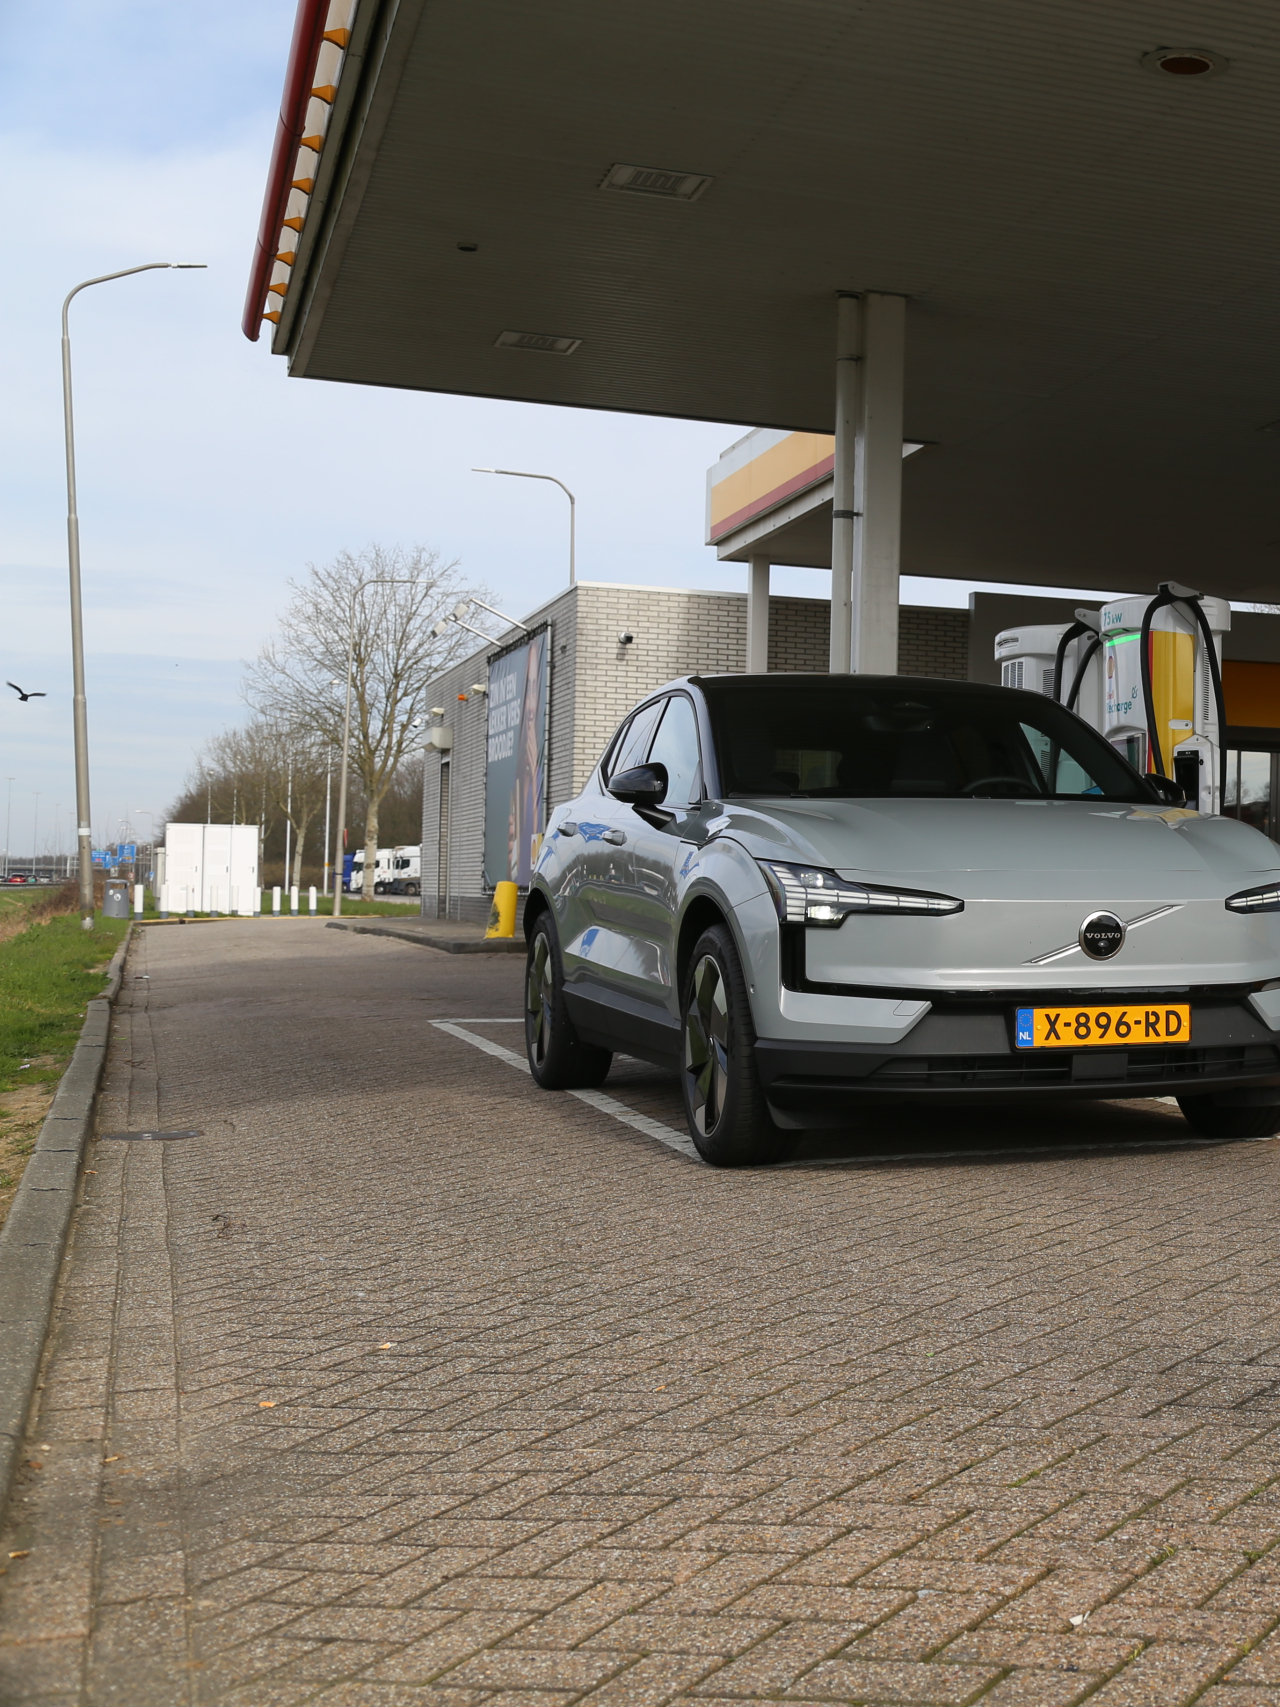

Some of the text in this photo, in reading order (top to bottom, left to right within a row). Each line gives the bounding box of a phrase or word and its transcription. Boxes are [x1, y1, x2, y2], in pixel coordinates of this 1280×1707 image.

[1111, 612, 1123, 625] kW
[507, 698, 521, 728] VERS
[1044, 1009, 1182, 1041] X-896-RD
[1019, 1031, 1032, 1041] NL
